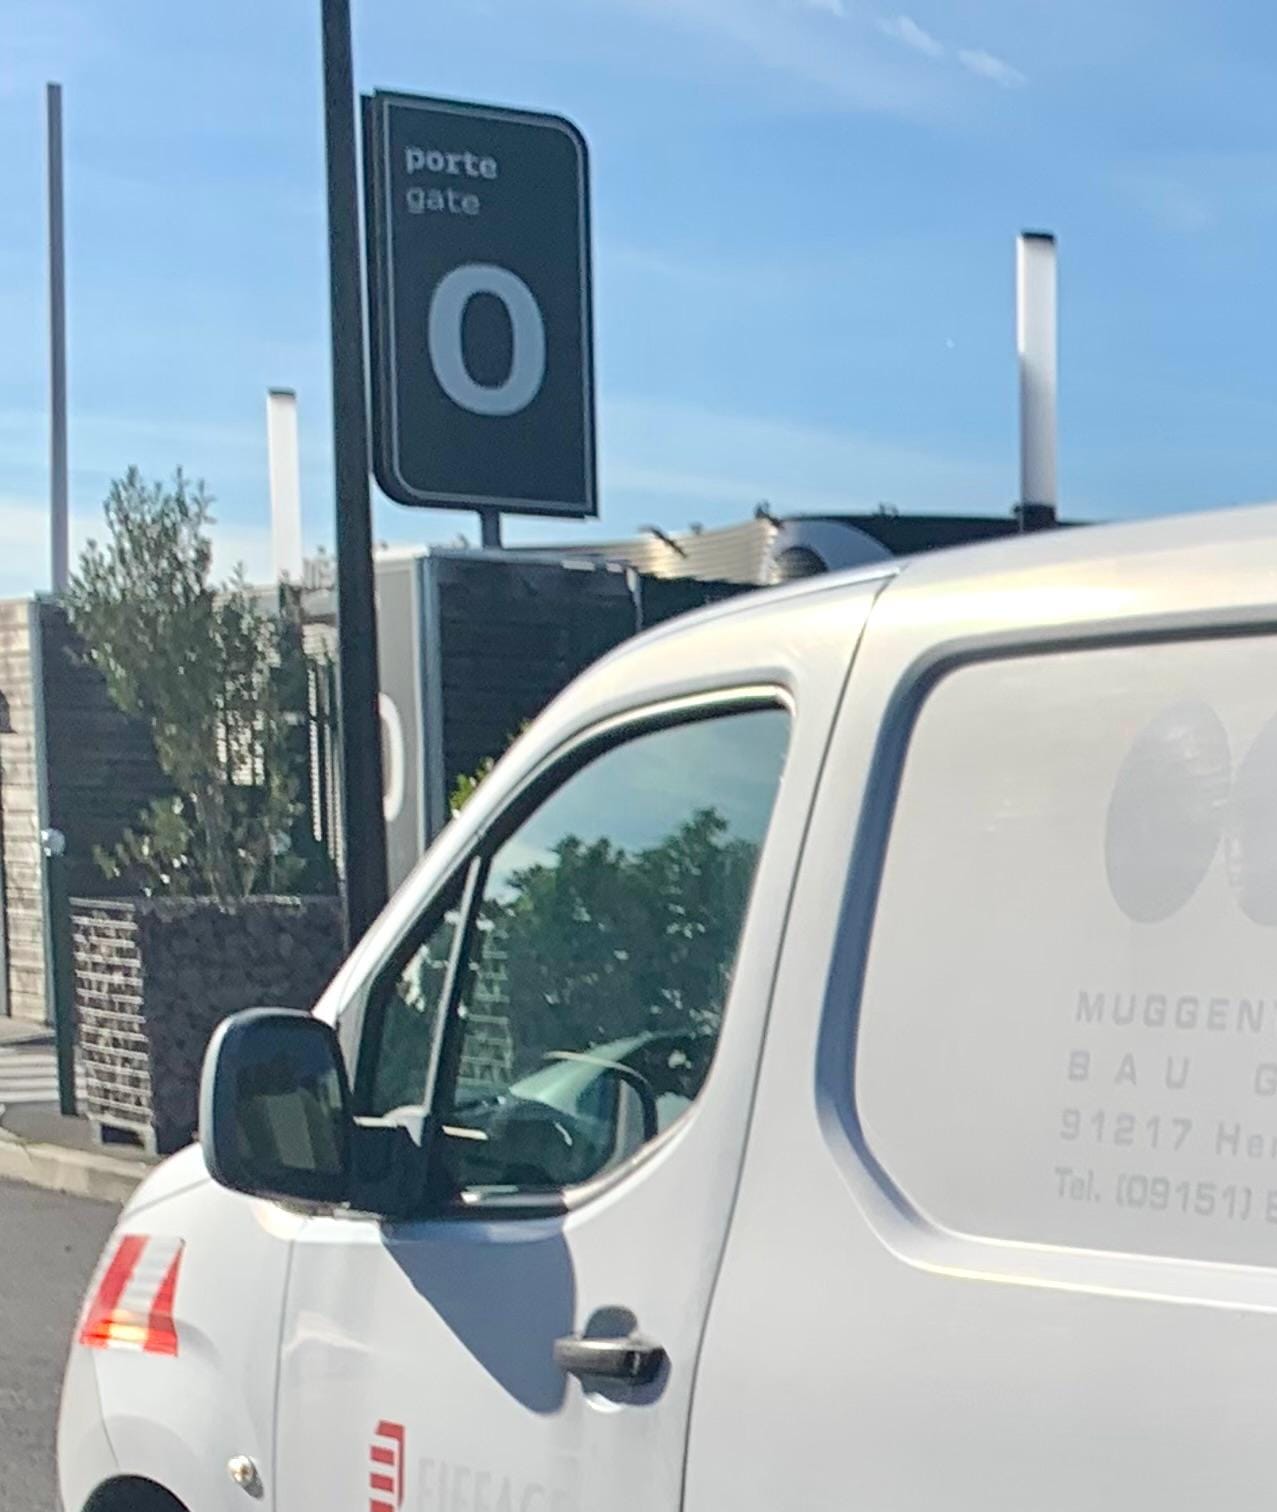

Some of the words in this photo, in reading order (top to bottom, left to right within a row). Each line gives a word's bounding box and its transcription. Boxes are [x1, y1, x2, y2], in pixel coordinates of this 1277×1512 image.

[405, 146, 498, 180] porte
[405, 186, 481, 216] gate
[1066, 1049, 1192, 1090] BAU
[1058, 1107, 1193, 1151] 91217
[1054, 1165, 1102, 1203] Tel.
[1115, 1173, 1253, 1222] (09151)
